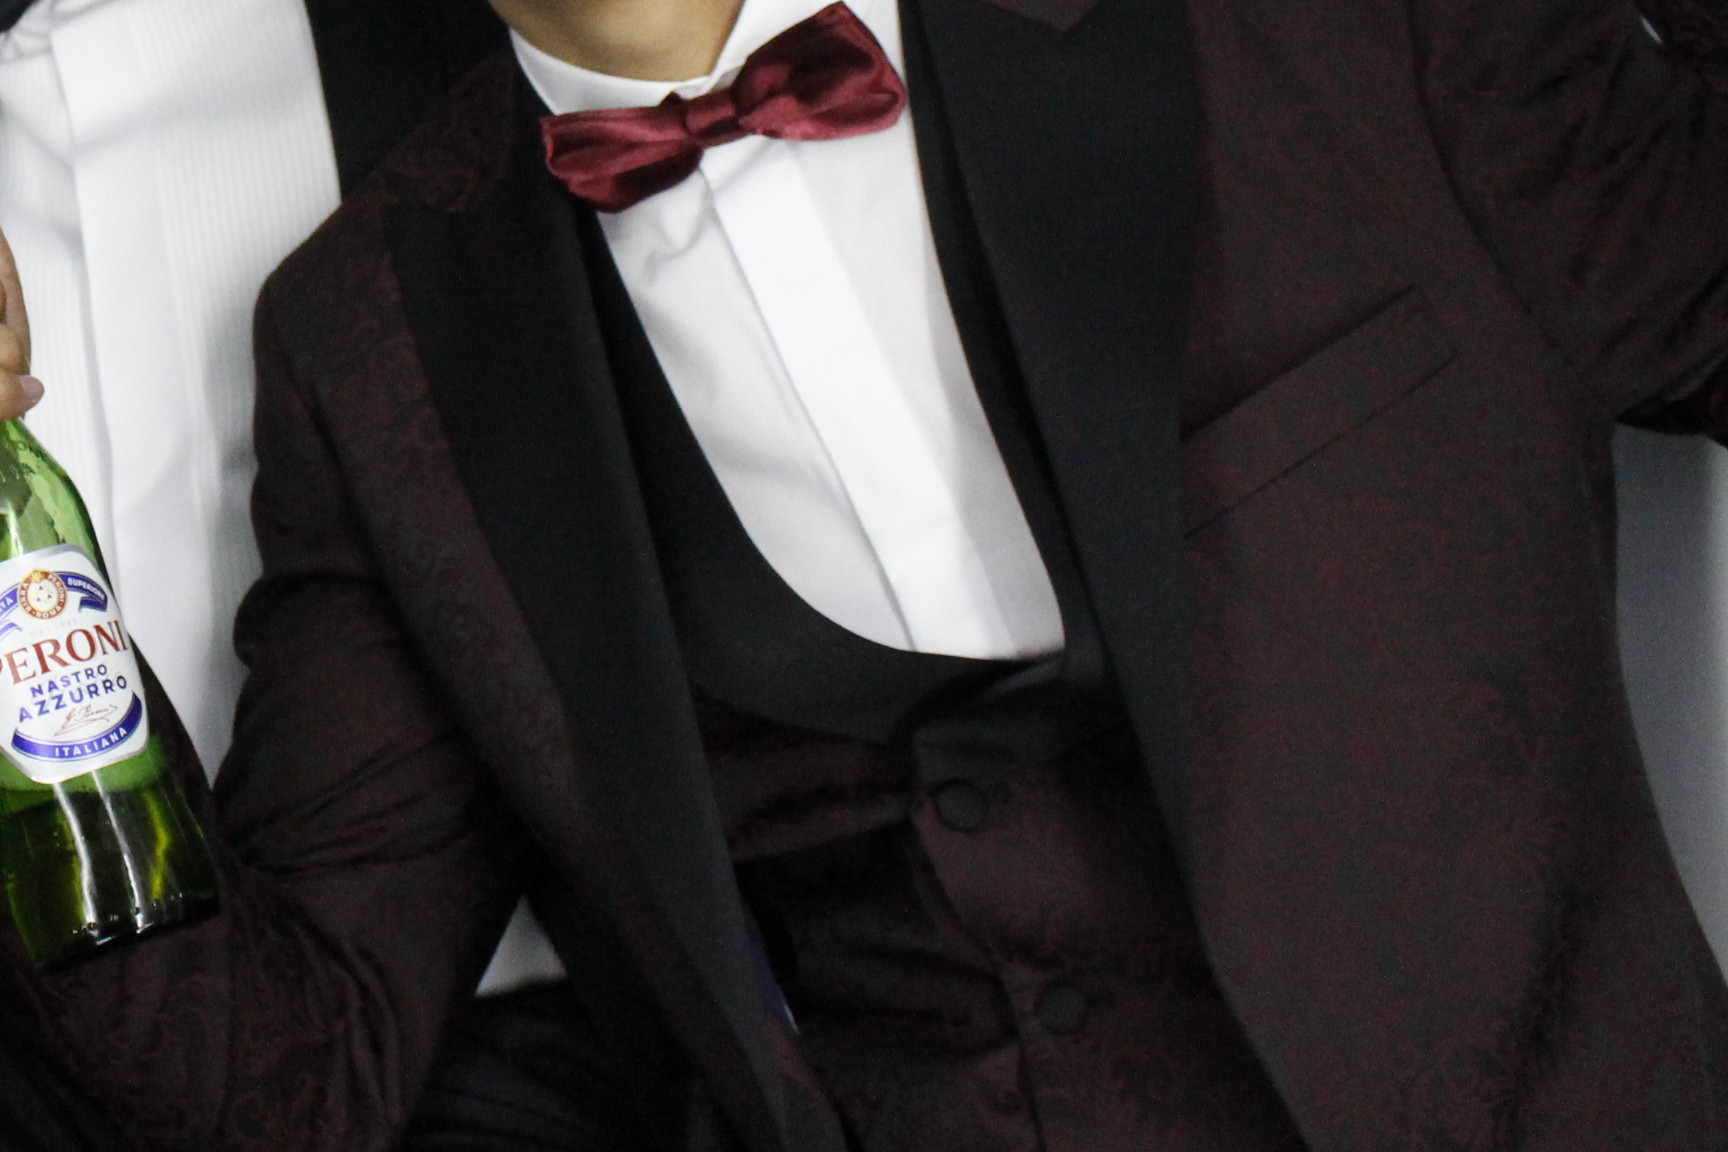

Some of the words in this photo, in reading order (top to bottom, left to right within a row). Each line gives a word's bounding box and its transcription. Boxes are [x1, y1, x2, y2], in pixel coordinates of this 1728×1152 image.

[30, 664, 107, 698] NASTRO
[19, 675, 127, 723] AZZURRO
[55, 727, 128, 756] ITALIANA
